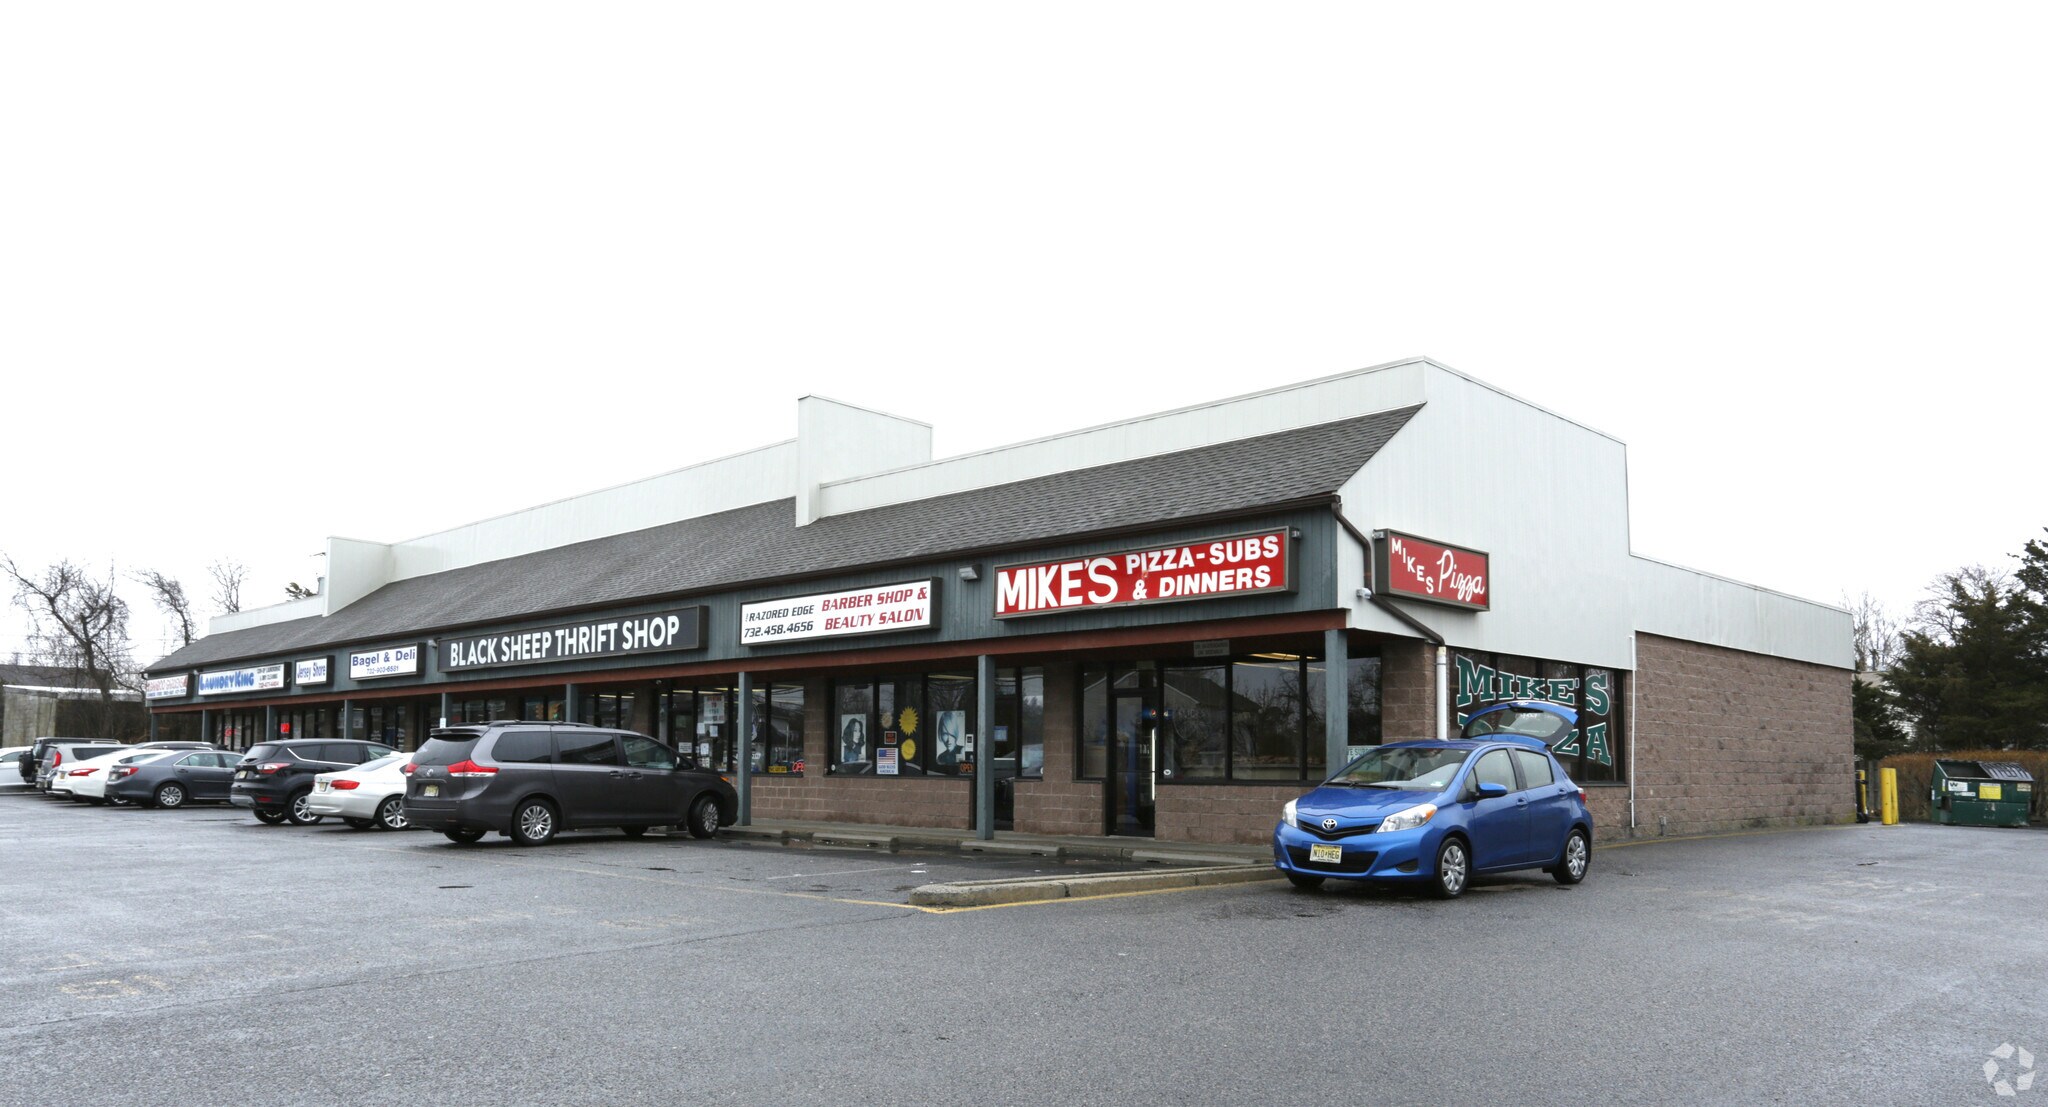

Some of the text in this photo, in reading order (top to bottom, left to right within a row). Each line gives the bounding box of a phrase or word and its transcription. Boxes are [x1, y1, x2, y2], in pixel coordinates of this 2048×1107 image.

[1391, 537, 1485, 602] MIKES Pizza
[996, 557, 1119, 613] MIKE'S
[1132, 565, 1271, 600] & DINNERS
[821, 587, 927, 612] BARBER SHOP &
[749, 608, 789, 622] RAZORED
[792, 605, 815, 617] EDGE
[824, 608, 924, 631] BEAUTY SALON
[450, 615, 680, 667] BLACK SHEEP THRIFT SHOP
[744, 621, 814, 638] 732.458.4656
[352, 649, 416, 667] Bagel & Deli
[297, 662, 311, 680] Jersey
[313, 662, 326, 677] Shore
[1455, 654, 1610, 716] MIKE'S
